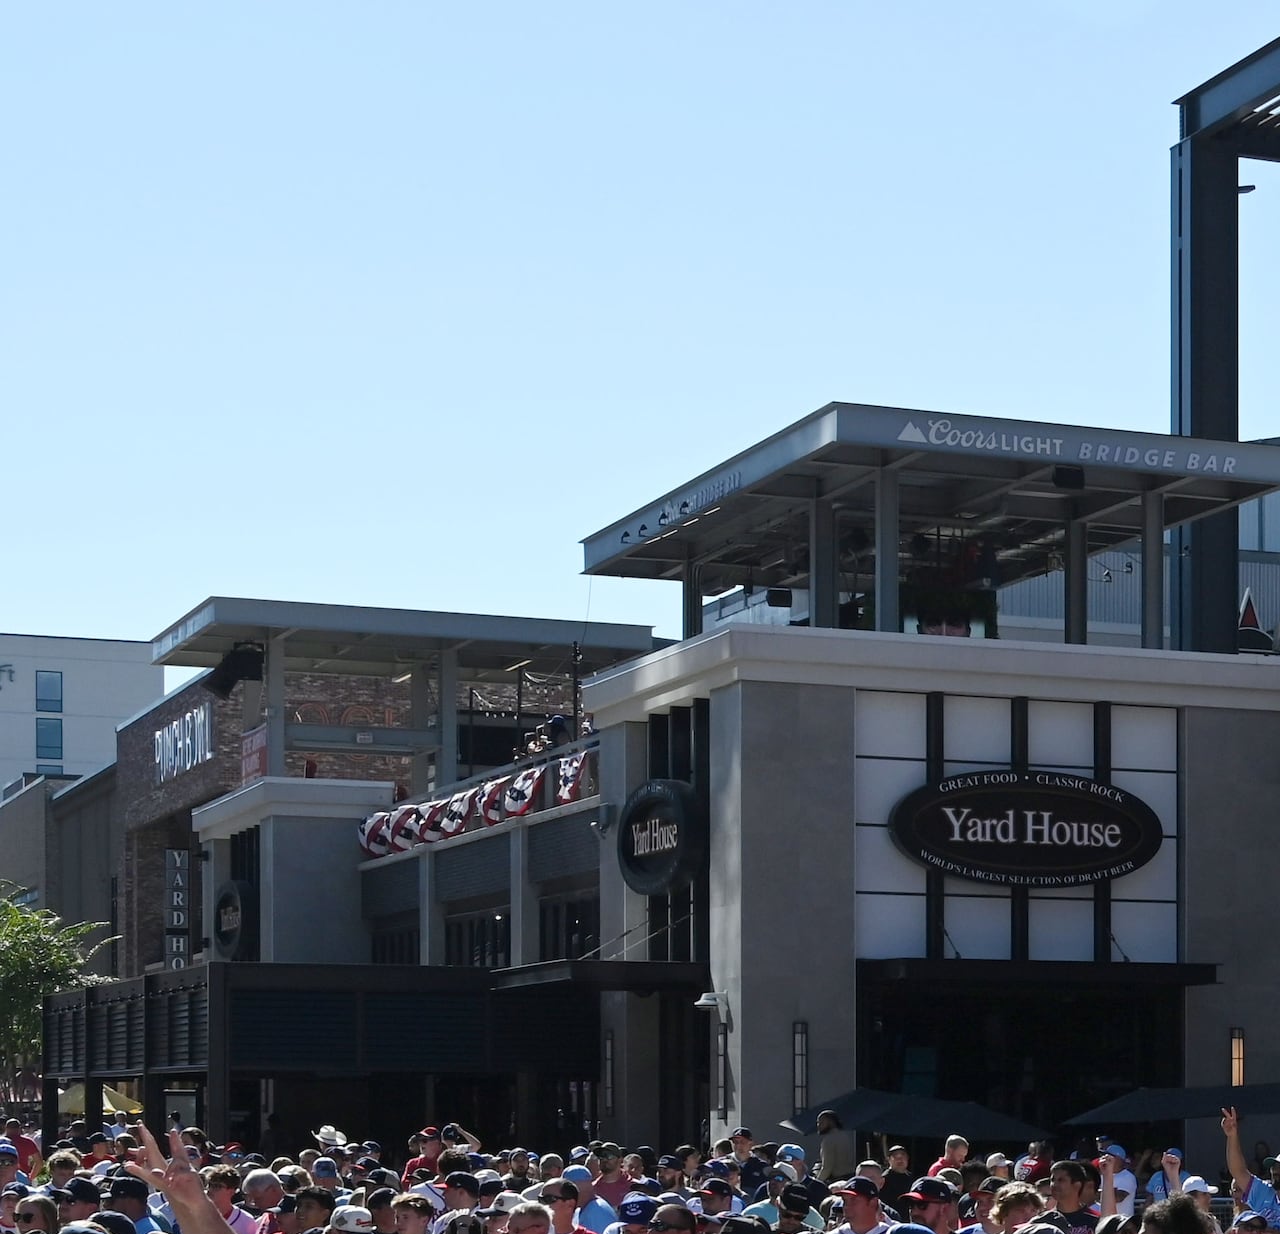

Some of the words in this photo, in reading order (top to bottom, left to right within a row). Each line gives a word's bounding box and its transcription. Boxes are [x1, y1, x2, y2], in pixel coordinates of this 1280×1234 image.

[927, 418, 1000, 449] Coors
[1001, 433, 1063, 456] LIGHT
[1078, 442, 1174, 468] BRIDGE
[1186, 451, 1238, 474] BAR
[938, 774, 981, 793] GREAT
[983, 773, 1018, 785] FOOD
[1036, 773, 1088, 791] CLASSIC
[1089, 783, 1125, 803] ROCK
[632, 820, 652, 857] Yard
[651, 818, 679, 852] House
[941, 807, 1017, 842] Yard
[1023, 810, 1122, 848] House
[920, 848, 961, 874] WORLD'S
[962, 866, 1008, 883] LARGEST
[1008, 874, 1062, 885] SELECTION
[1063, 875, 1076, 884] OF
[1078, 869, 1110, 882] DRAFT
[1110, 860, 1135, 875] BEER
